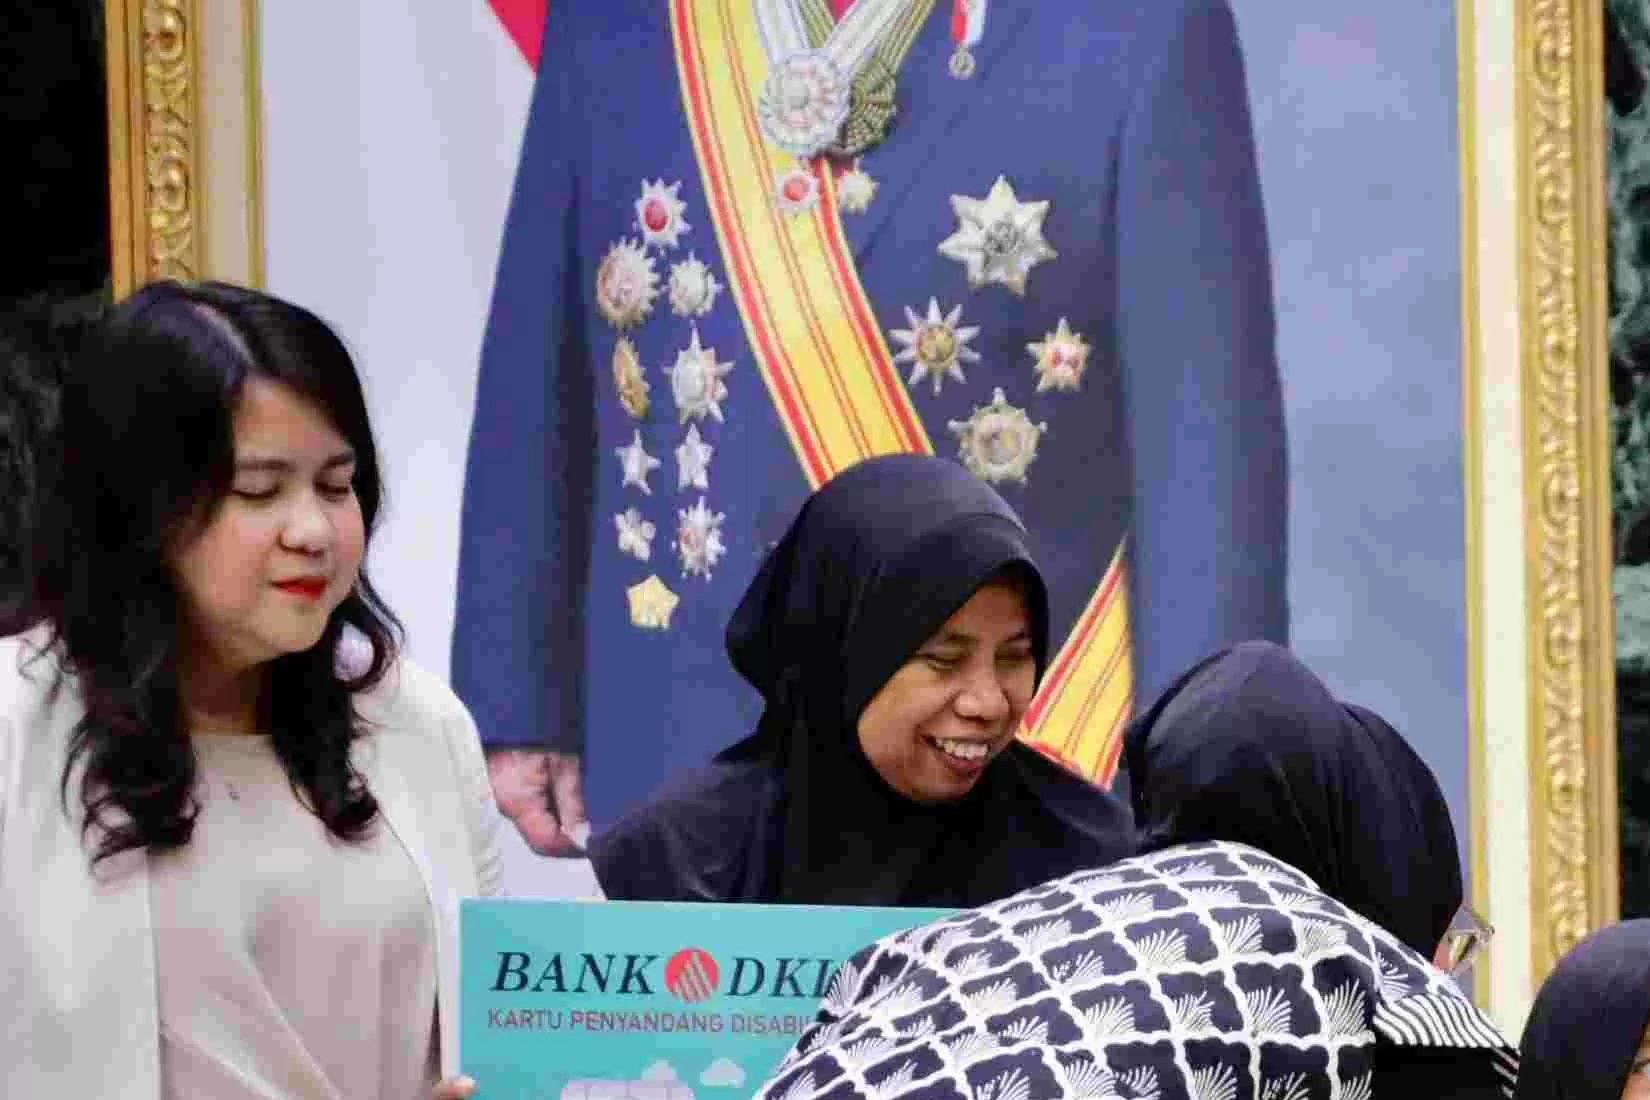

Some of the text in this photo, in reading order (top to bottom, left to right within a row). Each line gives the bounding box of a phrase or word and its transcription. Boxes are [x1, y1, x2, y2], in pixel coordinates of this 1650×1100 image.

[489, 951, 832, 998] BANK DKI
[487, 1008, 563, 1031] KARTU
[569, 1009, 724, 1034] PENYANDANG
